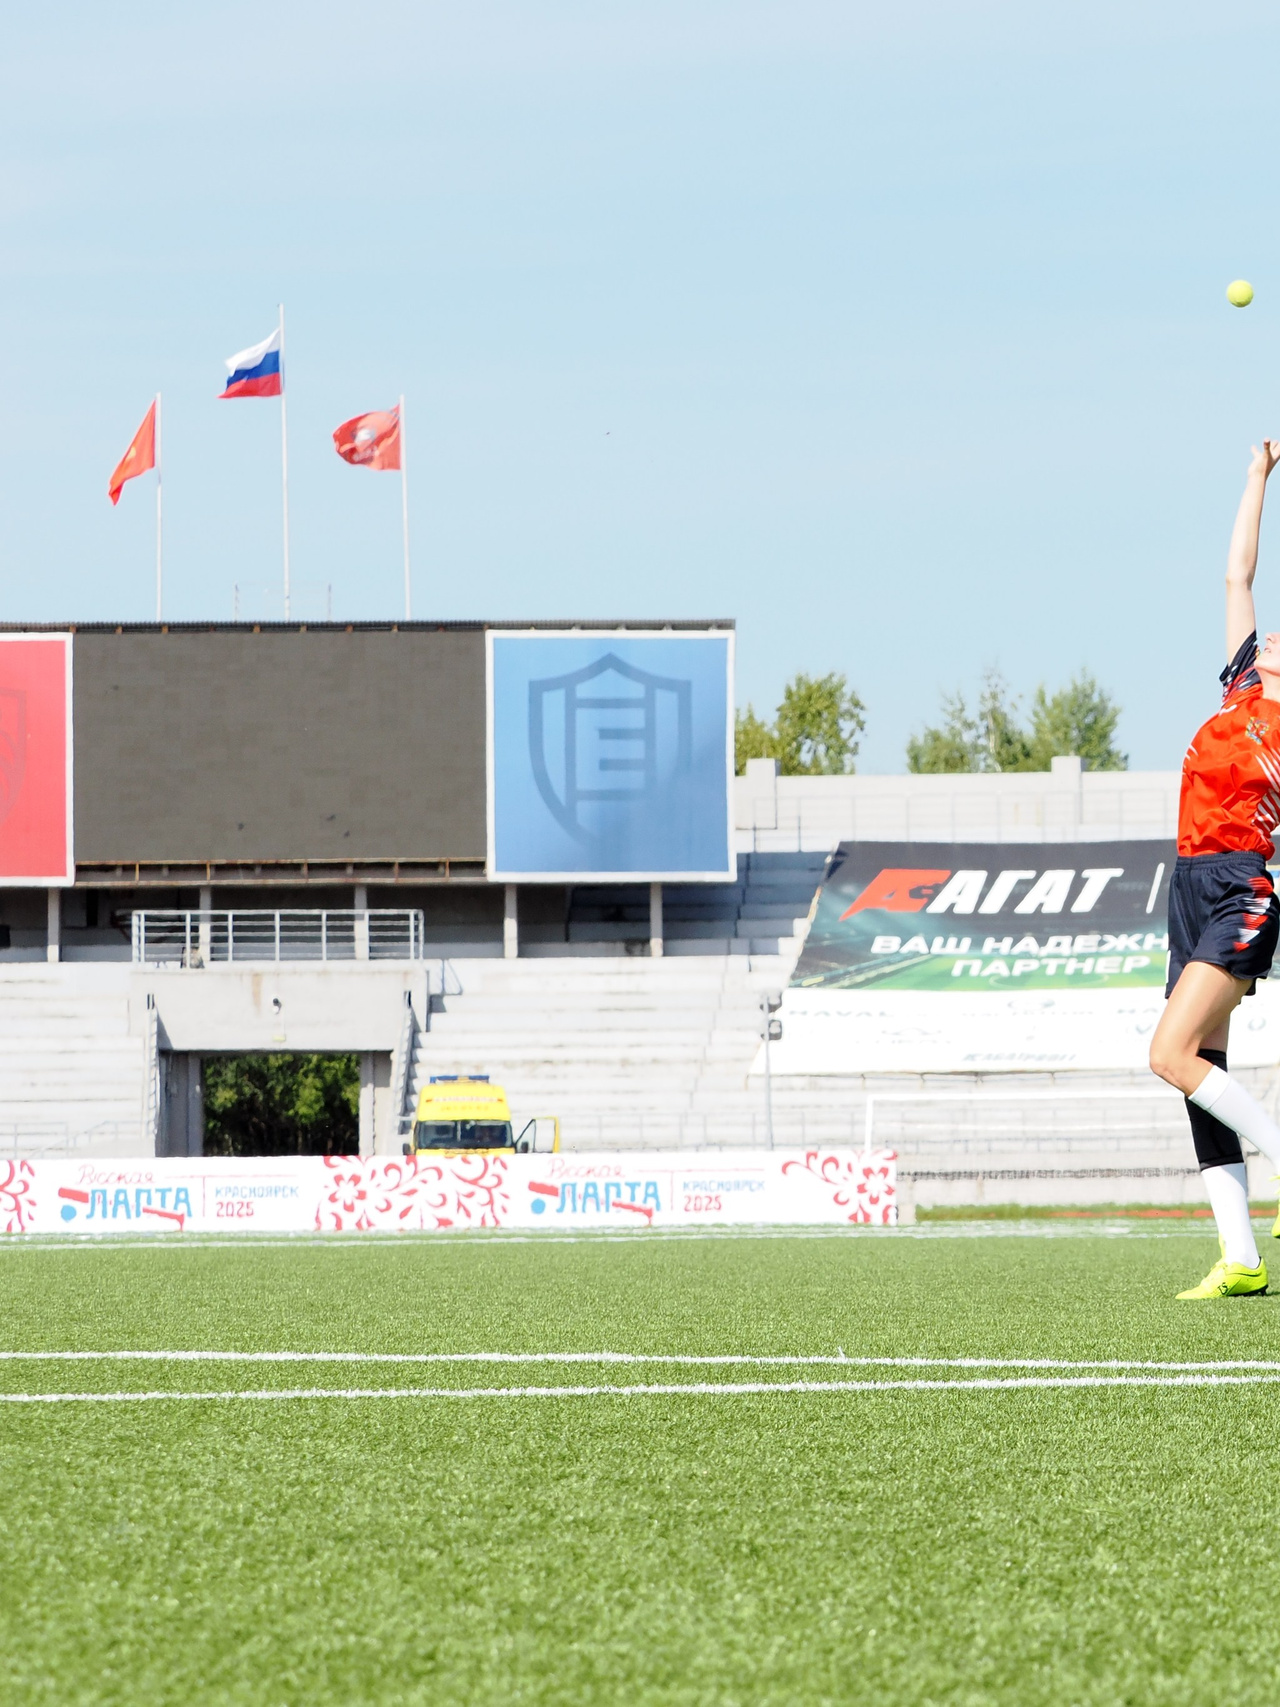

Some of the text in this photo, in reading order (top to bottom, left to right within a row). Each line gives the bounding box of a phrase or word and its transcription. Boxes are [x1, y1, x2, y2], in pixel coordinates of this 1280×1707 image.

[926, 868, 1124, 914] АГАТ
[870, 935, 972, 954] ВАШ
[951, 955, 1151, 977] ПАРТНЕР
[215, 1185, 300, 1199] КРАСНОЯРСК
[683, 1179, 766, 1192] КРАСНОЯРСК
[86, 1187, 192, 1219] ЛАПТА
[556, 1181, 661, 1213] ЛАПТА
[684, 1195, 722, 1212] 2025
[216, 1201, 254, 1218] 2025
